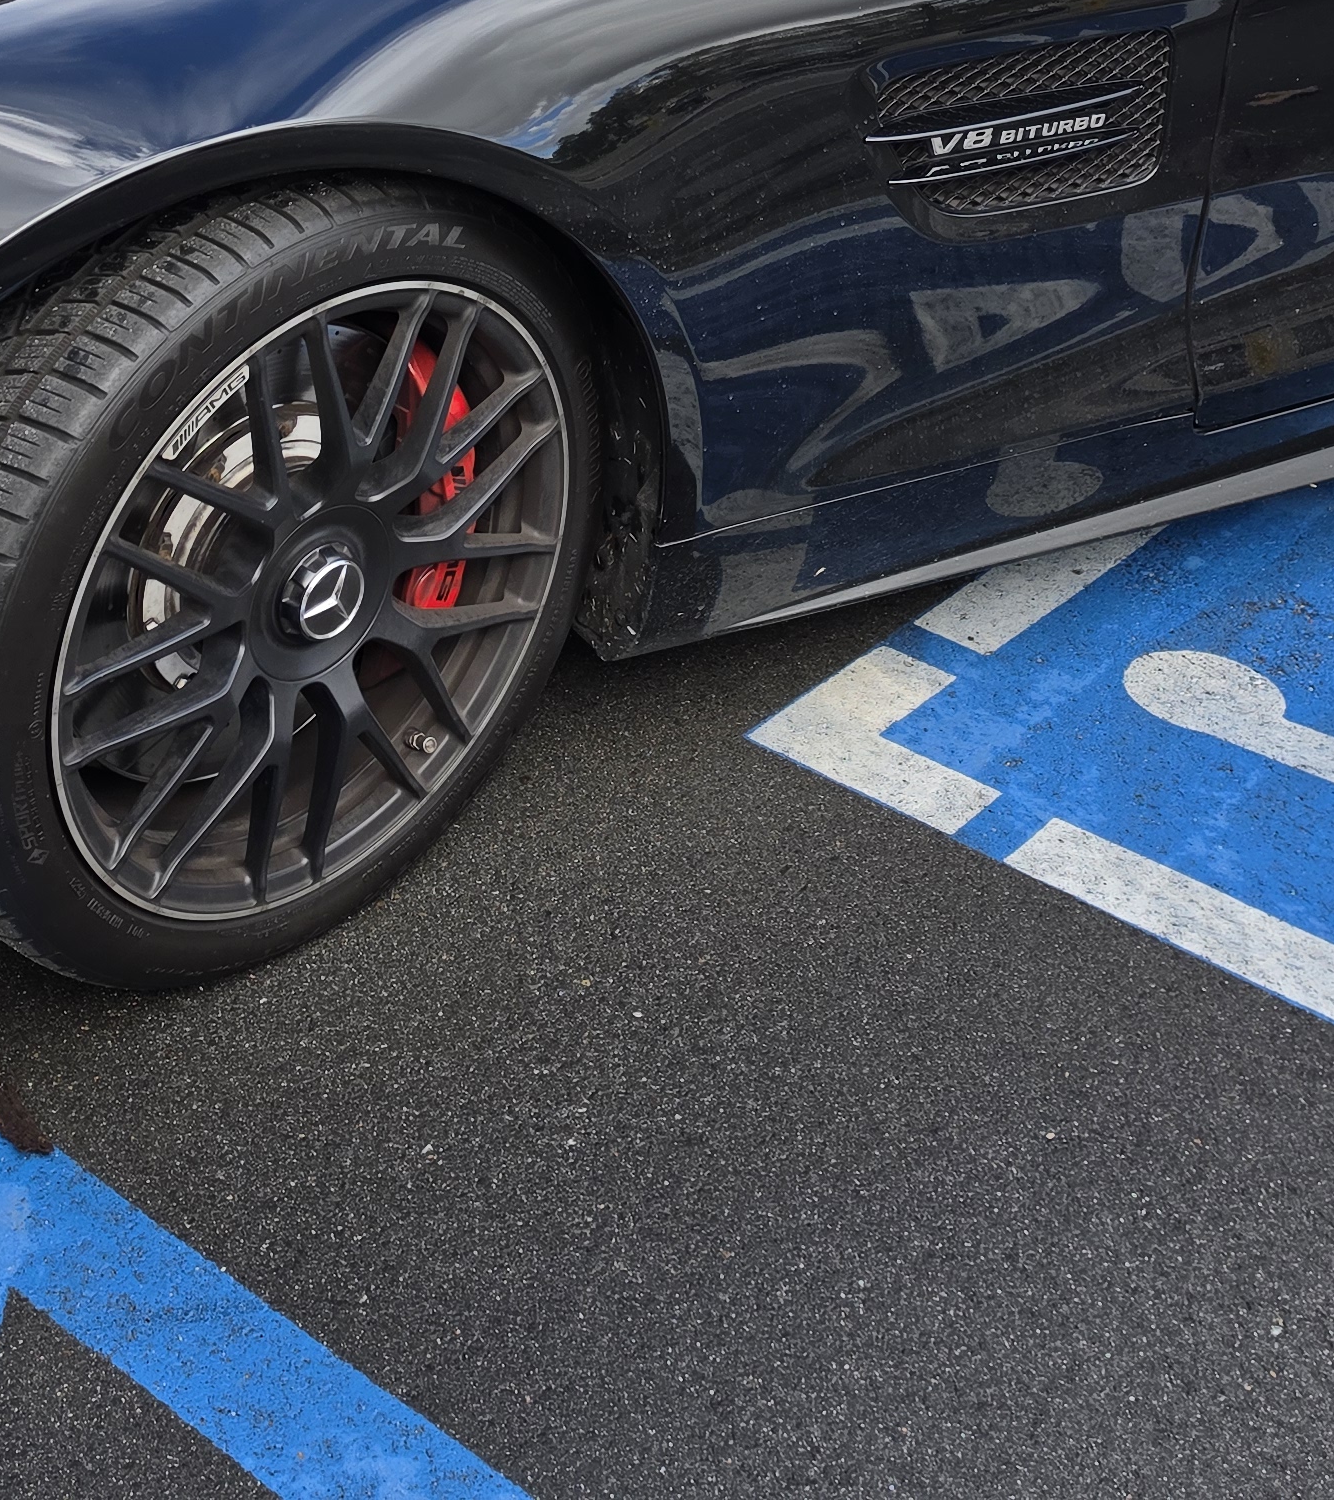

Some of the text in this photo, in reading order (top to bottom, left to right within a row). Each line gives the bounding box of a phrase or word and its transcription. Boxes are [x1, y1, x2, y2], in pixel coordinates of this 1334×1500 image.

[930, 113, 1106, 156] V8 BITURBO
[108, 222, 466, 451] CONTINENTAL
[194, 370, 246, 429] AMG
